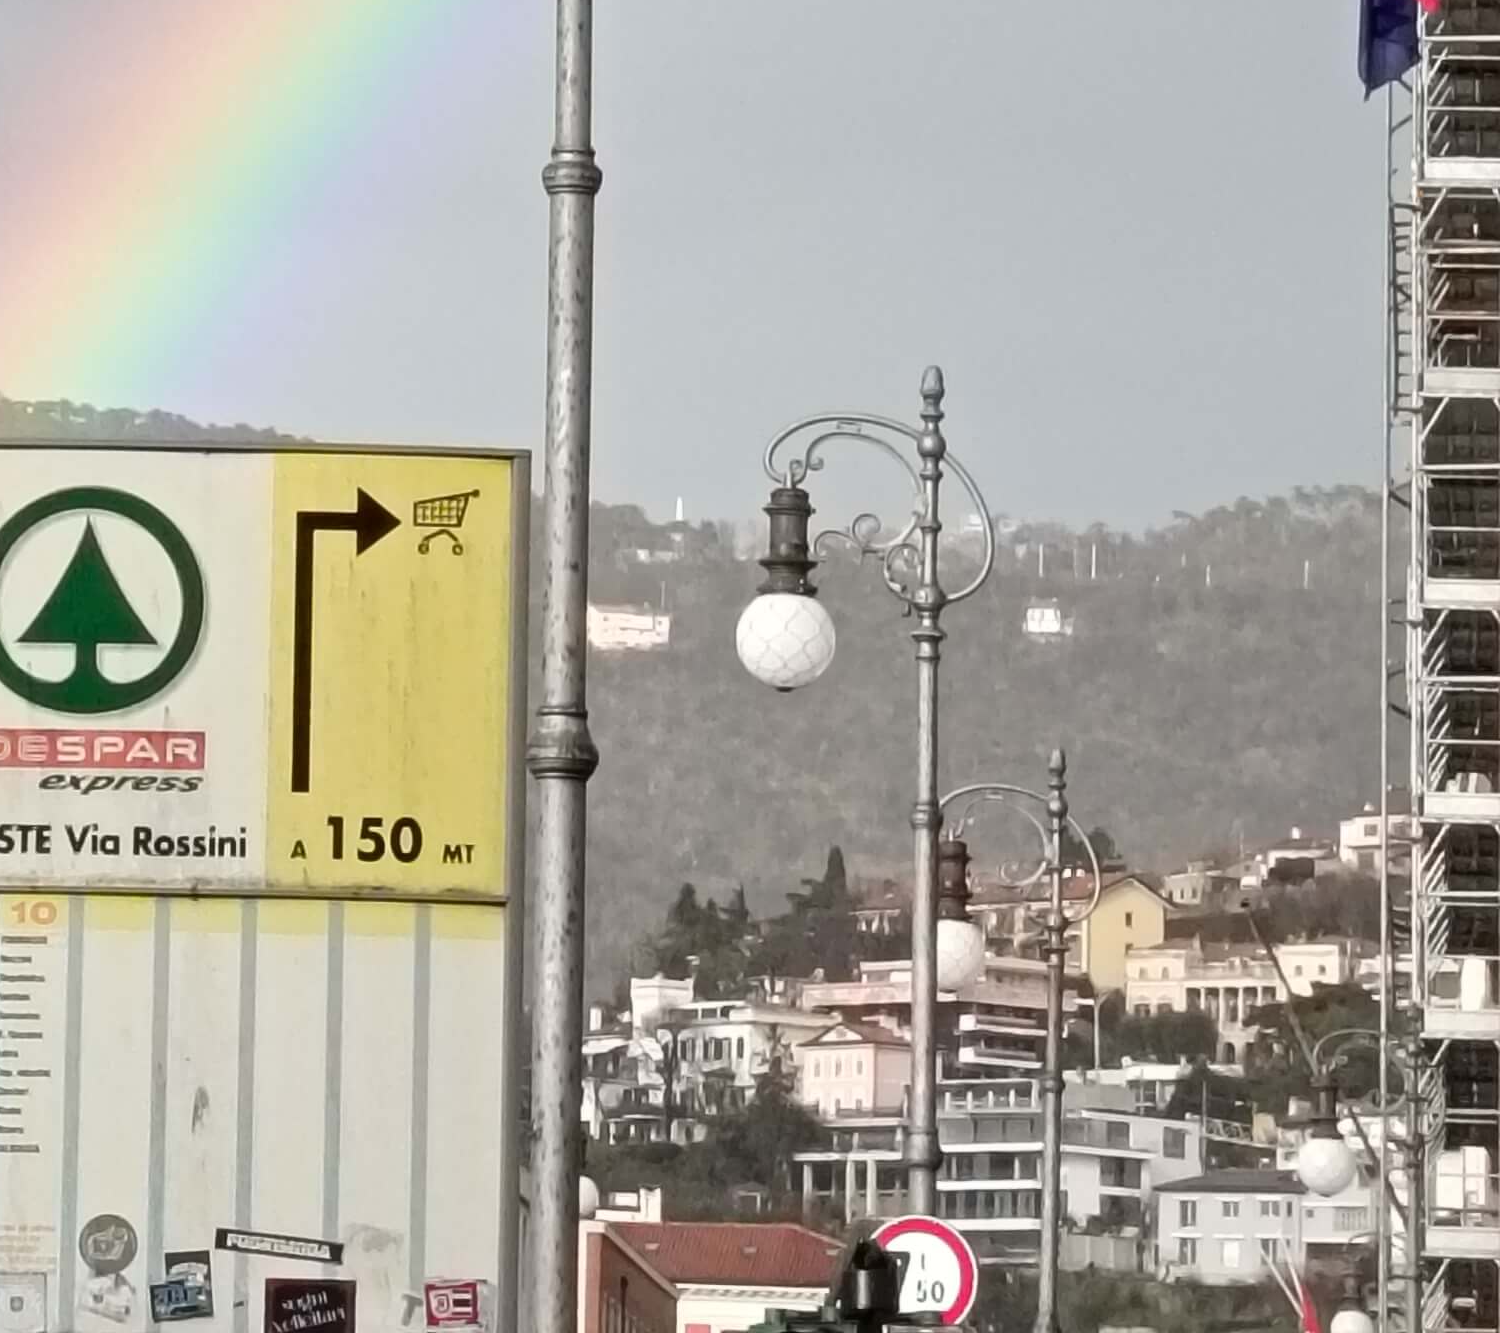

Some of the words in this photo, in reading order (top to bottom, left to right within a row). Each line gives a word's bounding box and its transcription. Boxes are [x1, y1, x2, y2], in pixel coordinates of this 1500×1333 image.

[38, 773, 204, 795] express
[64, 822, 121, 856] Via
[132, 825, 247, 858] Rossini
[290, 839, 307, 860] A
[326, 815, 423, 864] 150
[441, 844, 475, 864] MT
[10, 901, 58, 925] 10
